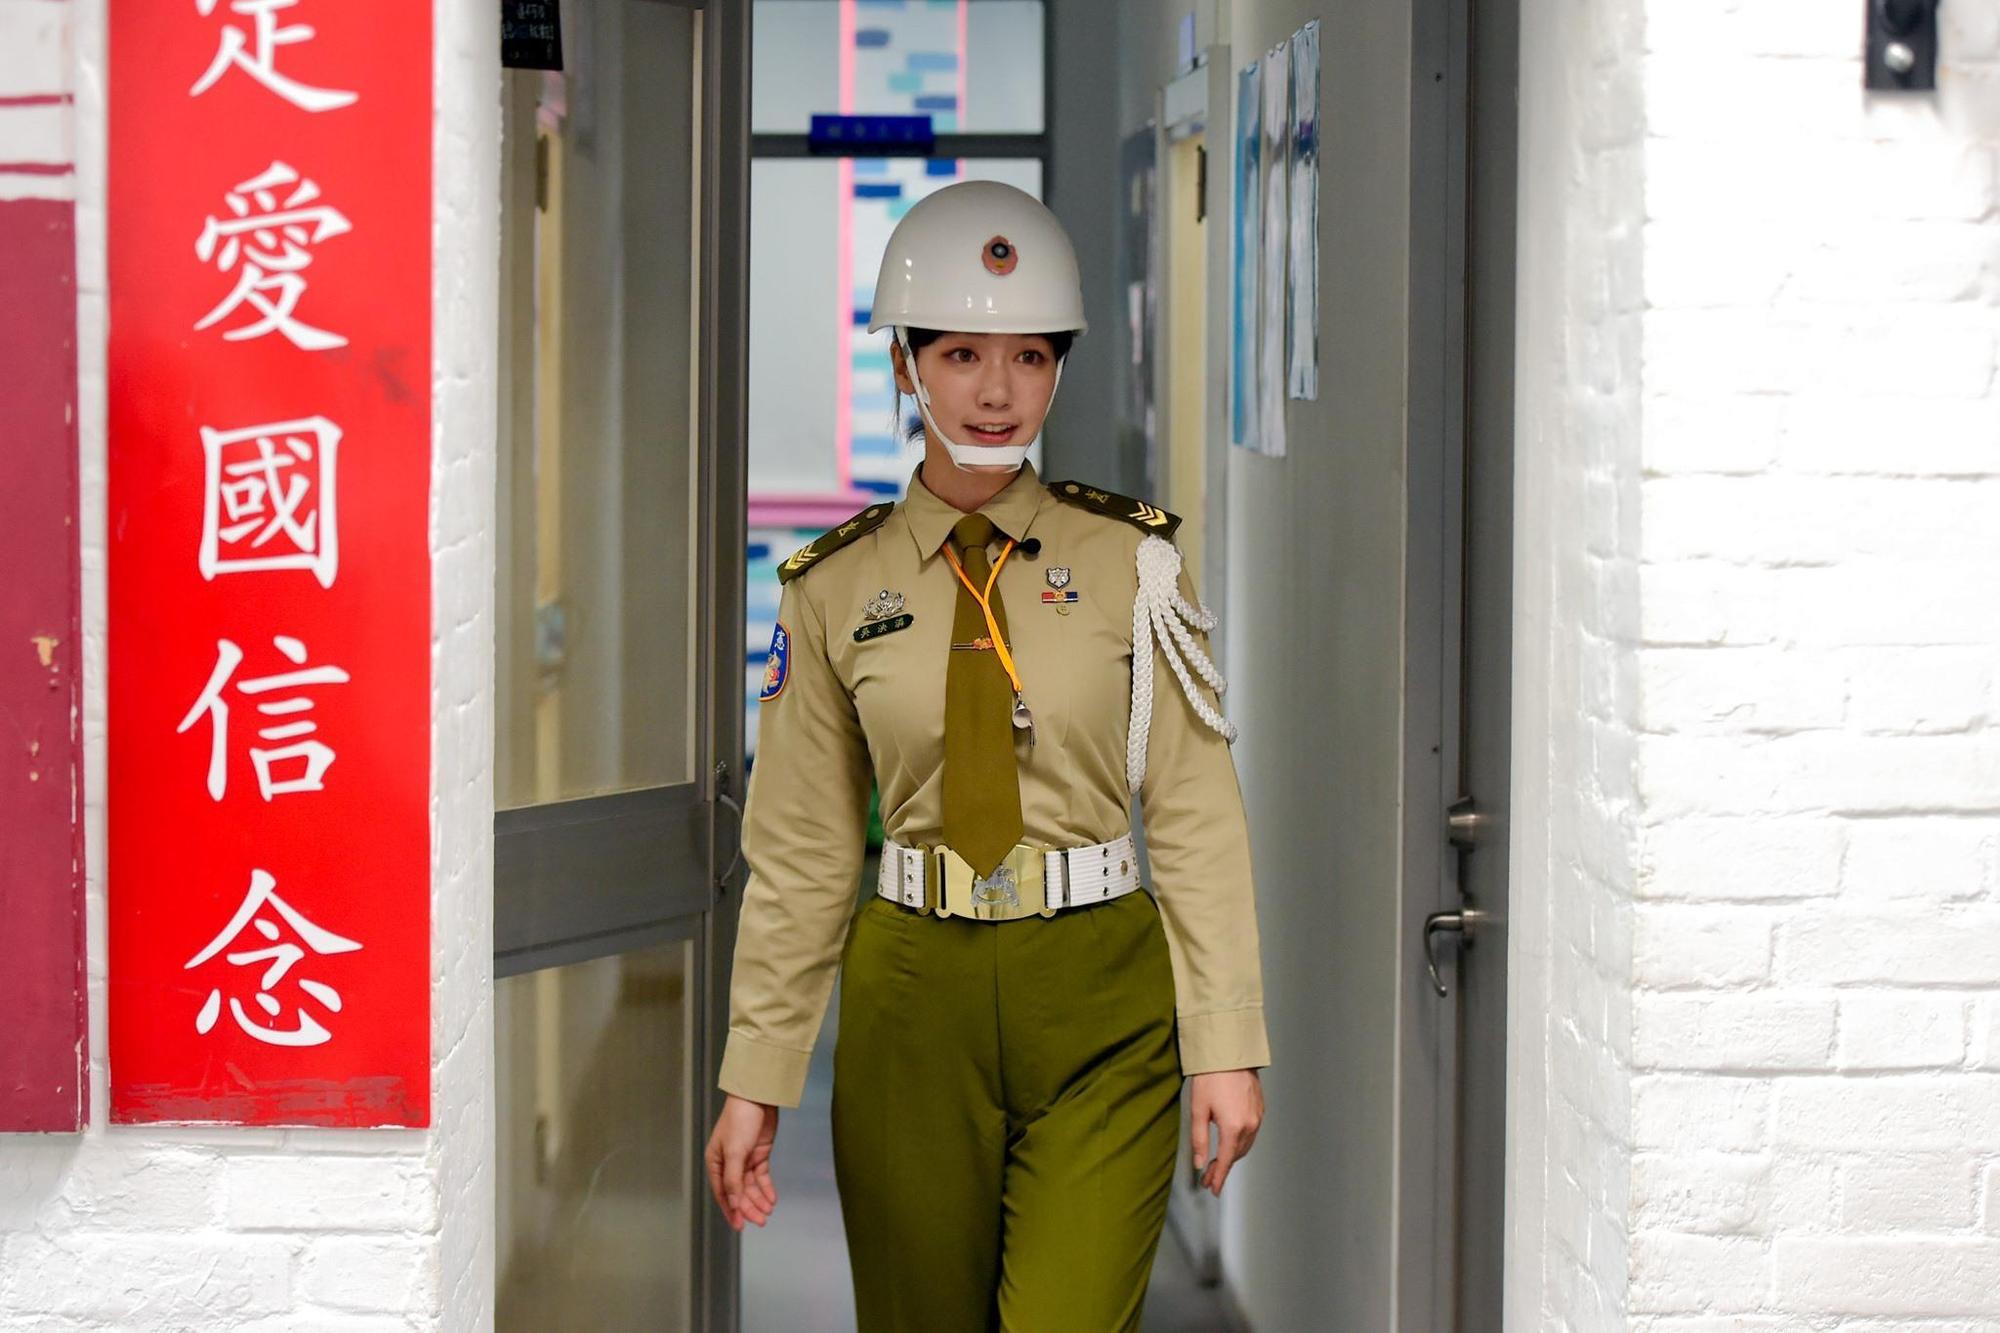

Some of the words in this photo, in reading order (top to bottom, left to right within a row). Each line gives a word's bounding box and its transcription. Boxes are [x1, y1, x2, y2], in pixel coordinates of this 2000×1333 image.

[178, 0, 362, 1046] 定愛國信念
